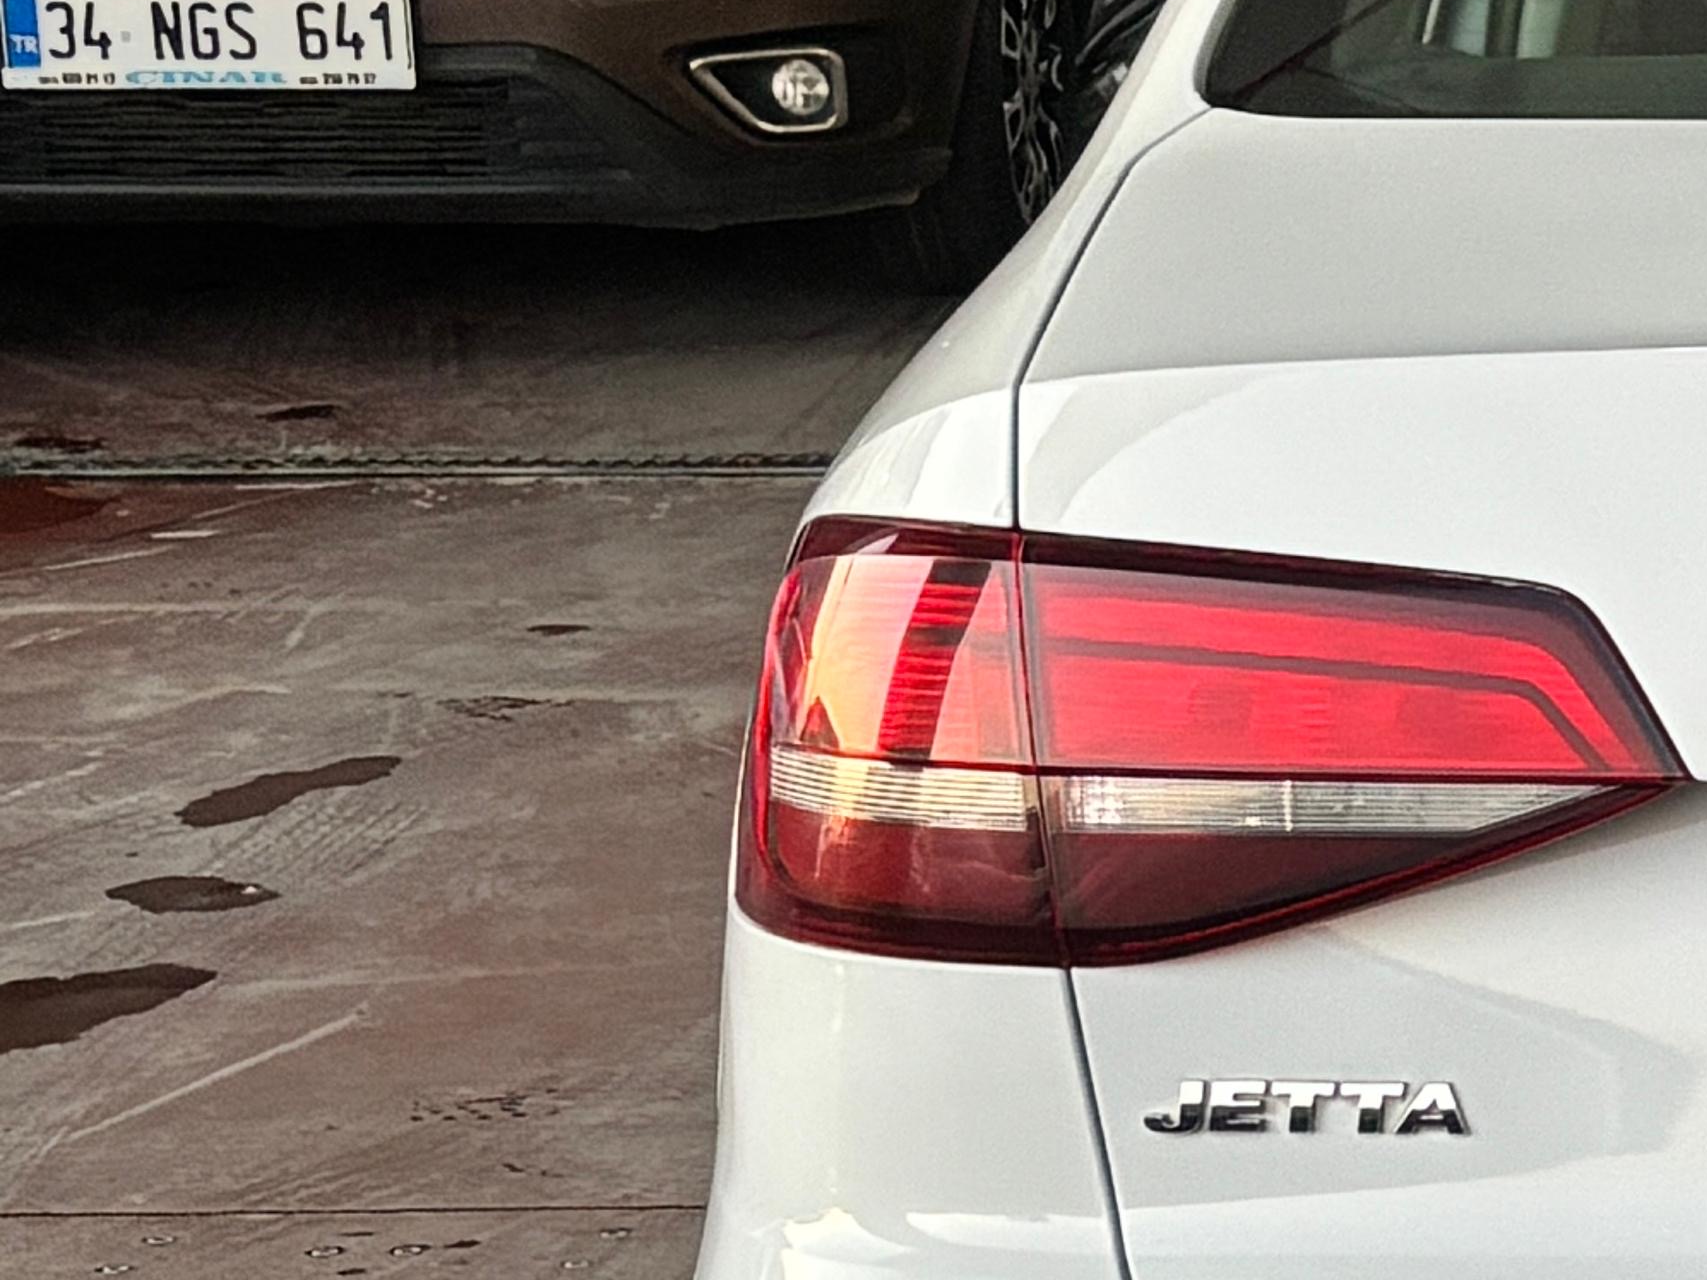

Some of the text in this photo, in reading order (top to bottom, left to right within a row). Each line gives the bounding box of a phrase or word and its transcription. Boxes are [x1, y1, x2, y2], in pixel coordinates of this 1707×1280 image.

[12, 34, 38, 55] TR
[45, 1, 393, 61] 34 NGS 641
[1144, 1078, 1472, 1136] JETTA
